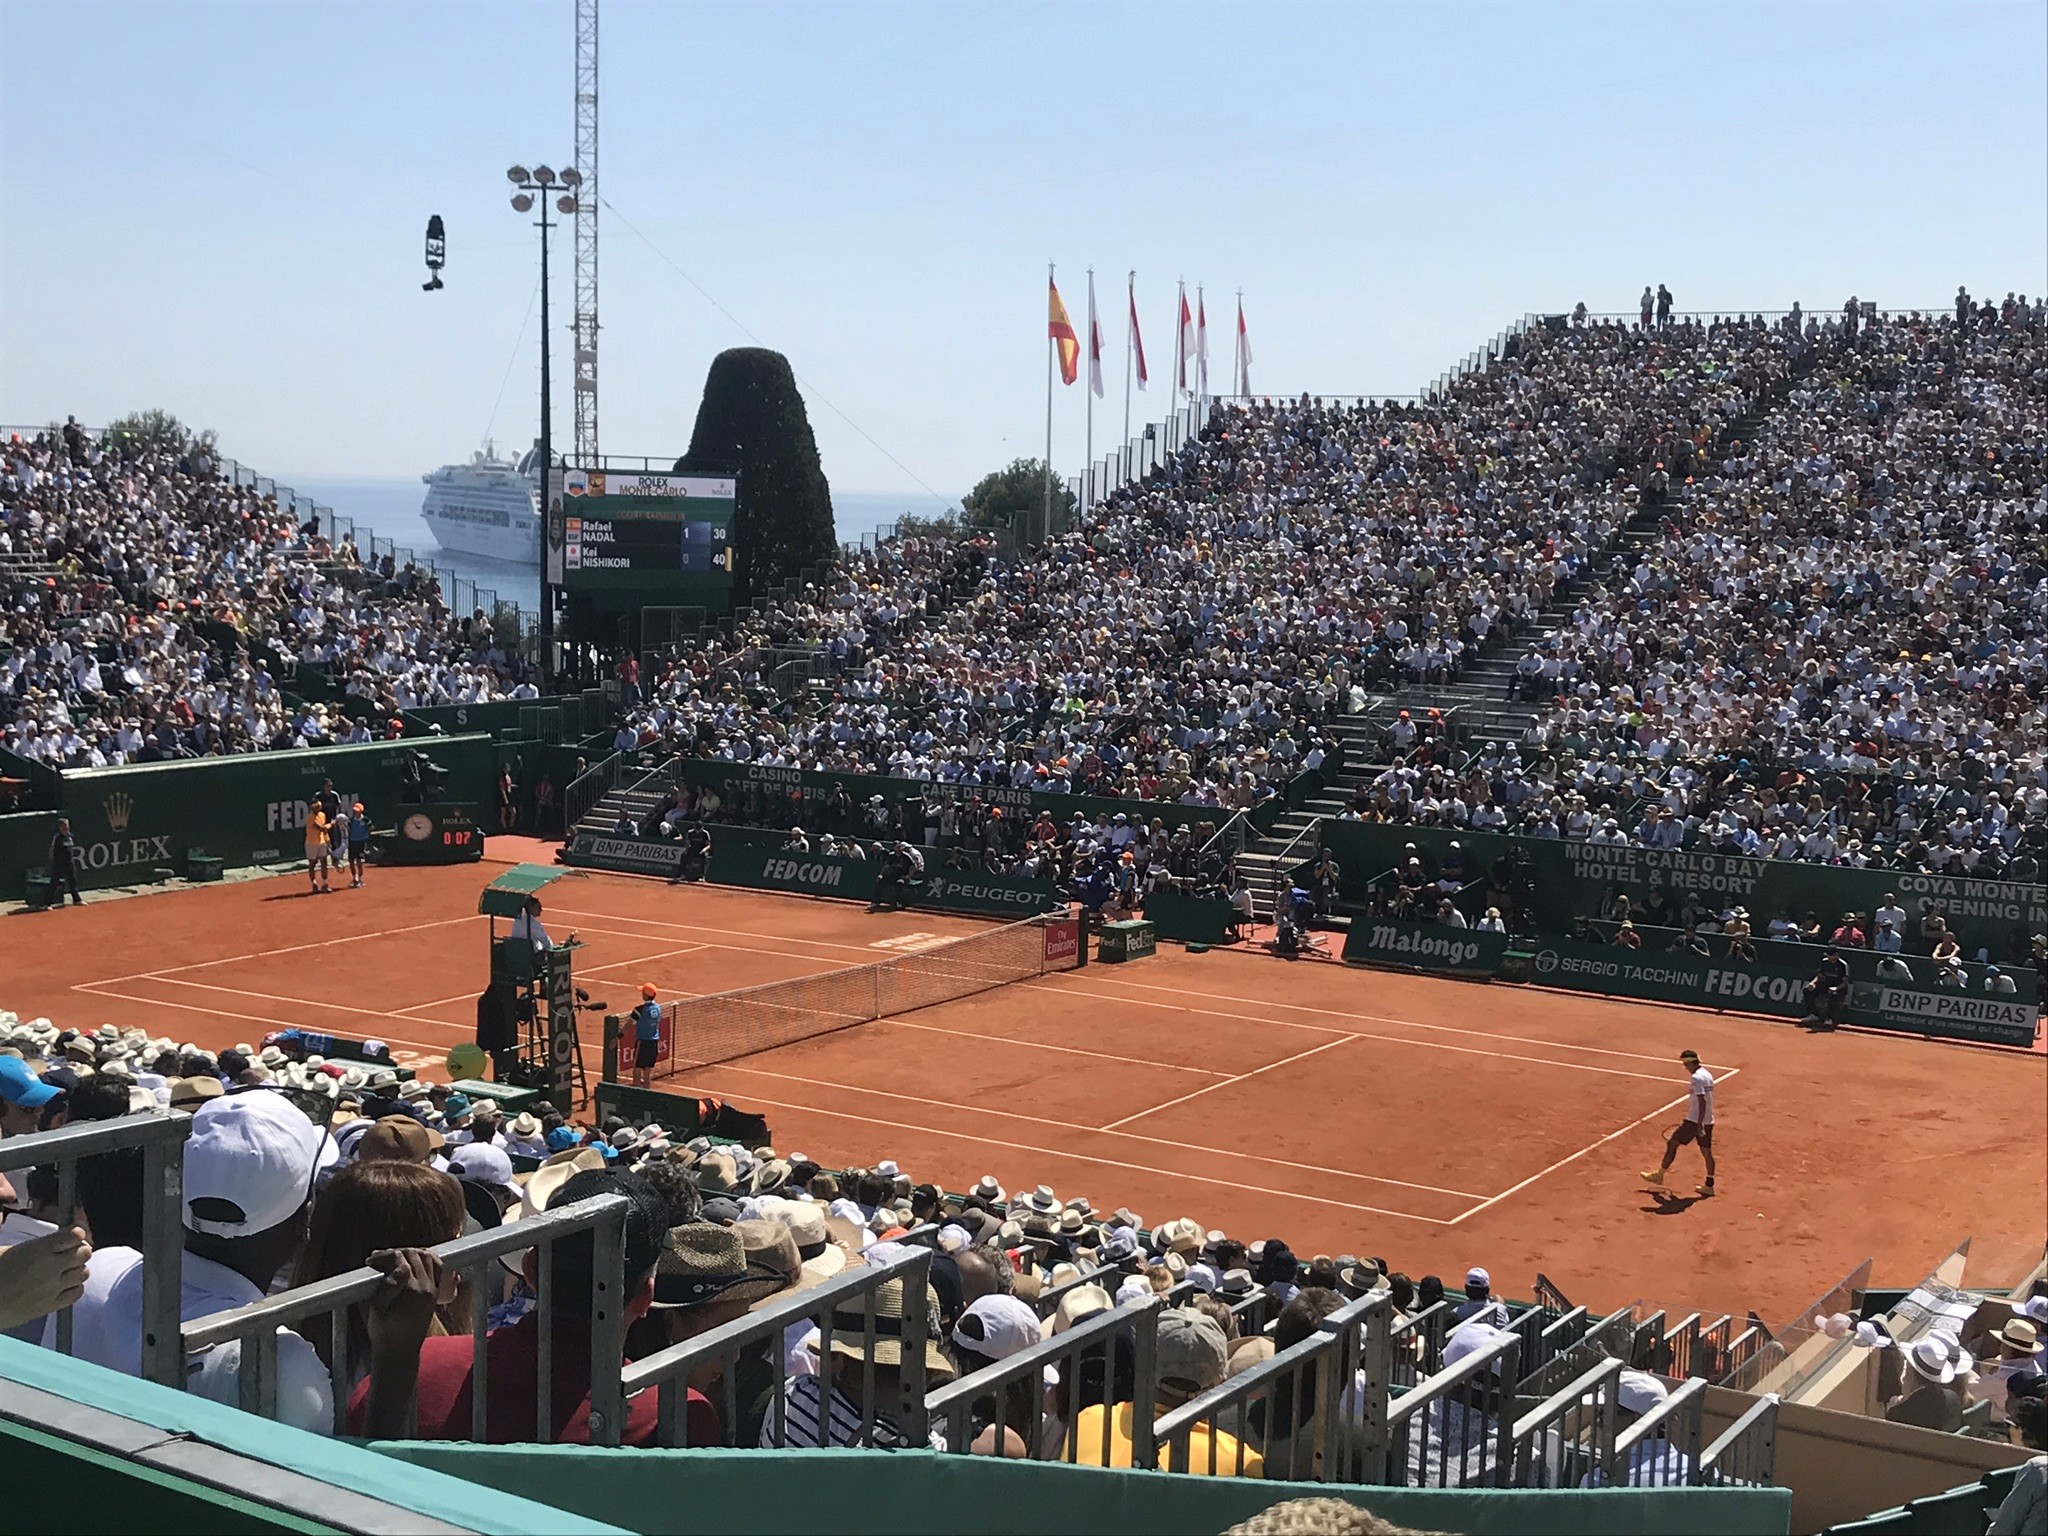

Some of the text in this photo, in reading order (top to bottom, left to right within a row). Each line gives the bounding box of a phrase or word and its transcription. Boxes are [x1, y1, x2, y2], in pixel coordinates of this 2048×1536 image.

[619, 485, 687, 496] MONTE-CARLO
[638, 477, 668, 487] ROLEX
[582, 521, 612, 531] Rafael
[683, 528, 689, 538] 1
[713, 528, 726, 539] 30
[582, 532, 615, 542] NADAL
[582, 547, 598, 556] Kei
[682, 554, 689, 564] 0
[713, 554, 725, 565] 40
[582, 558, 630, 568] NISHIKORI
[748, 766, 802, 783] CASINO
[987, 789, 1032, 805] PARIS
[267, 793, 359, 831] FEDM
[442, 817, 472, 825] ROLEX
[71, 835, 172, 870] ROLEX
[596, 840, 679, 860] BNP PARIBAS
[1564, 844, 1768, 877] MONTE-CARLO BAY
[762, 858, 842, 886] FEDCOM
[1574, 861, 1757, 894] HOTEL & RESORT
[946, 883, 1046, 906] PEUGEOT
[1899, 876, 1957, 896] COYA
[1047, 938, 1076, 955] Emirates
[1369, 925, 1480, 965] Malongo
[1561, 957, 1699, 987] SERGIO TACCHINI
[1887, 992, 2027, 1023] BNP PARIBAS
[554, 963, 571, 1092] RICOH
